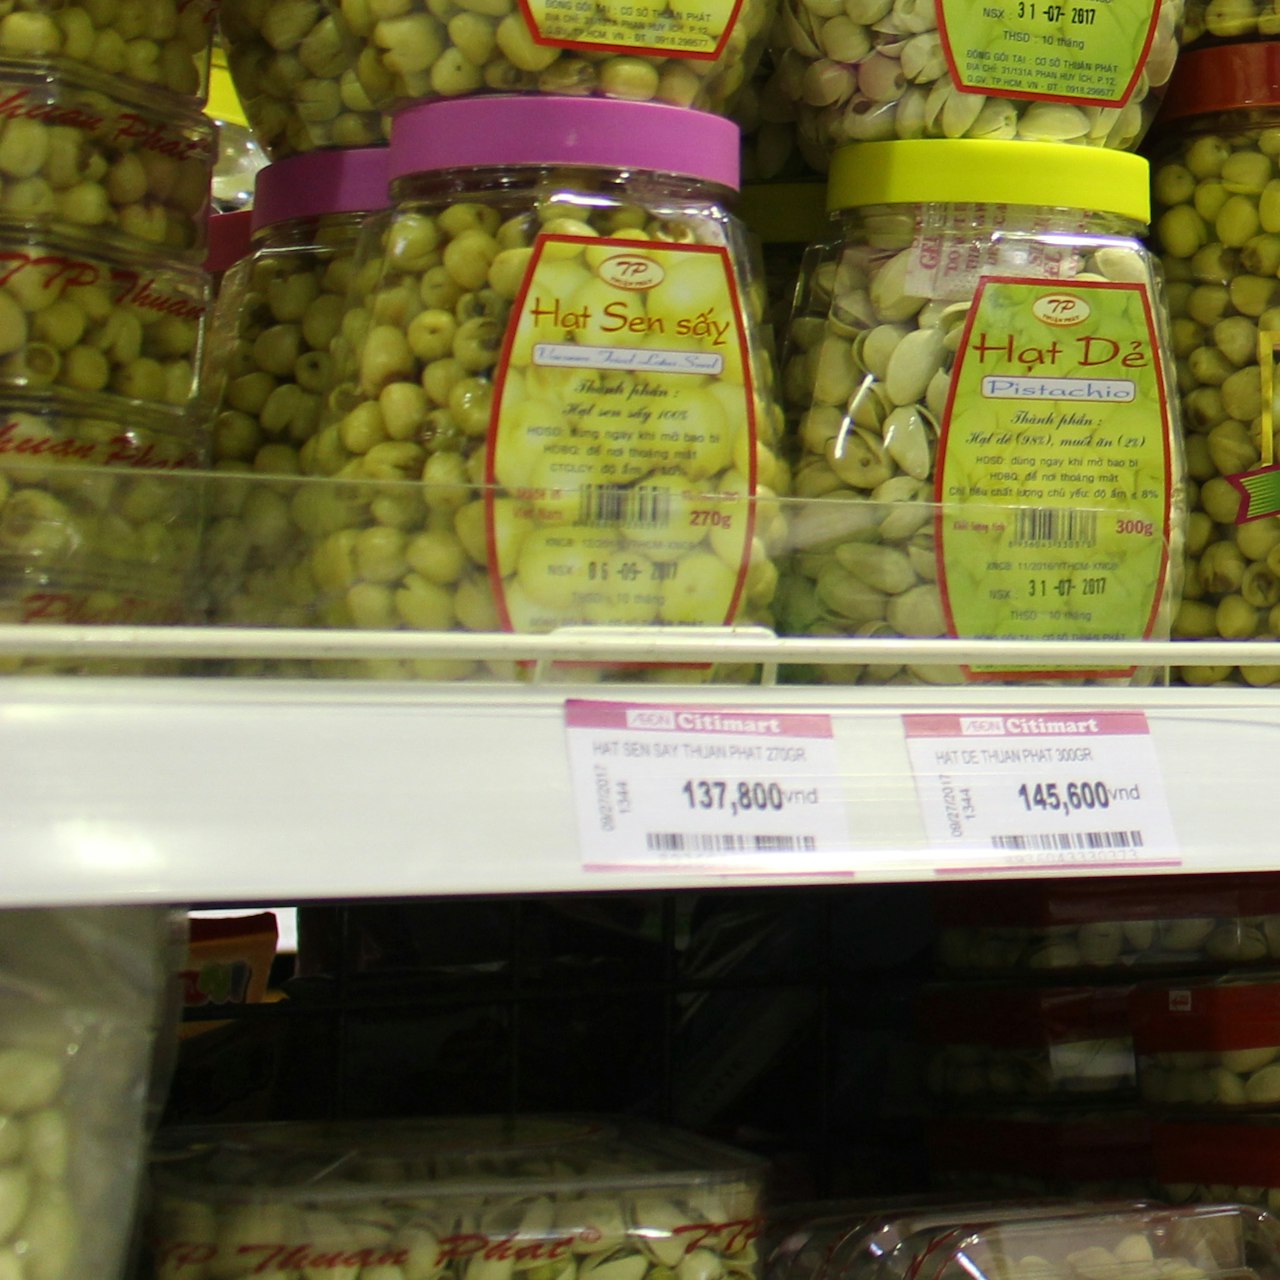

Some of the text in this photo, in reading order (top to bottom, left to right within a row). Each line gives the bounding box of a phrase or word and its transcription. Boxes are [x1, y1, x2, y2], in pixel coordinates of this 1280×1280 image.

[1072, 8, 1095, 25] 2017
[600, 302, 665, 333] Sen
[676, 307, 729, 346] sấy
[972, 333, 1148, 372] Hạt Dẻ
[988, 380, 1130, 398] Pistachio
[690, 511, 732, 529] 270g
[1116, 520, 1153, 536] 300g
[1083, 578, 1106, 595] 2017
[677, 713, 780, 733] Citimart
[1006, 718, 1098, 733] Citimart
[593, 742, 618, 756] HAT
[623, 742, 650, 758] SEN
[653, 744, 678, 758] SAY
[685, 744, 726, 759] THUAN
[730, 746, 761, 760] PHAT
[936, 748, 1092, 764] HAT DE THUAN PHAT 300GR
